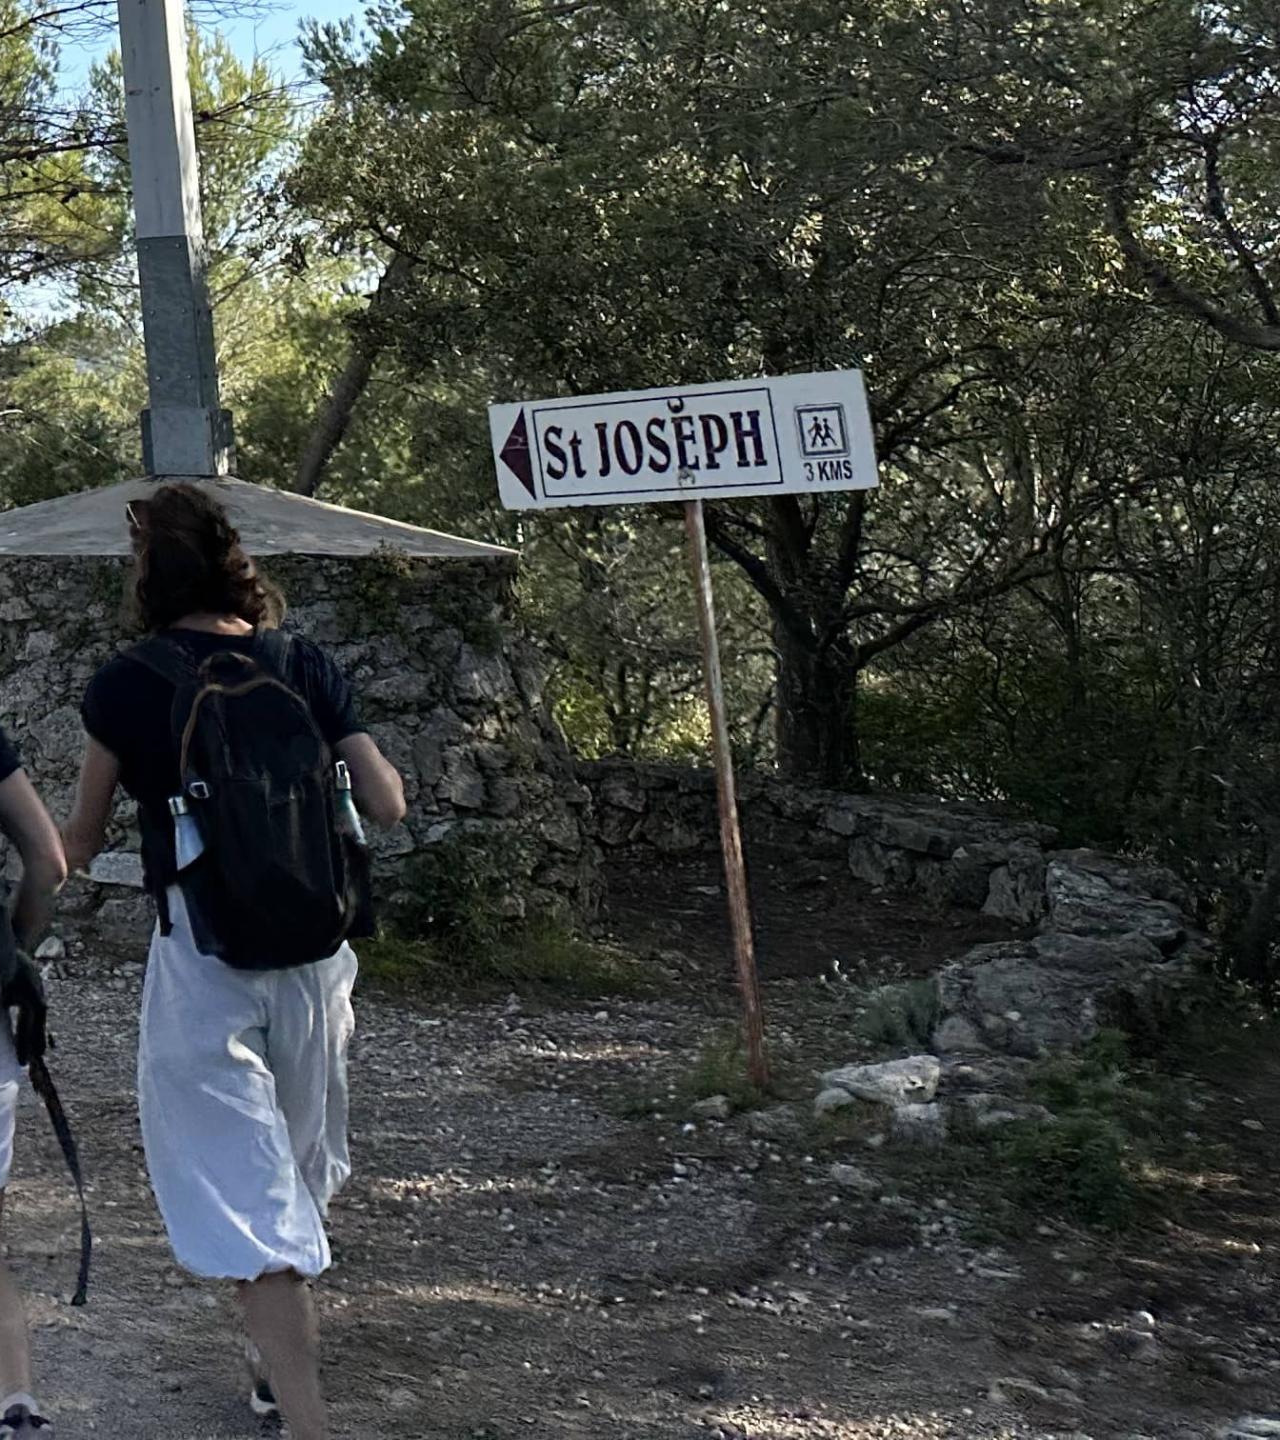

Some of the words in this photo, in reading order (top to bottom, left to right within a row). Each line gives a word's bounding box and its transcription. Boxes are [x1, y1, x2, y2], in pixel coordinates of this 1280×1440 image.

[543, 424, 587, 480] St
[594, 409, 768, 478] JOSEPH
[803, 461, 815, 482] 3
[817, 458, 853, 481] KMS
